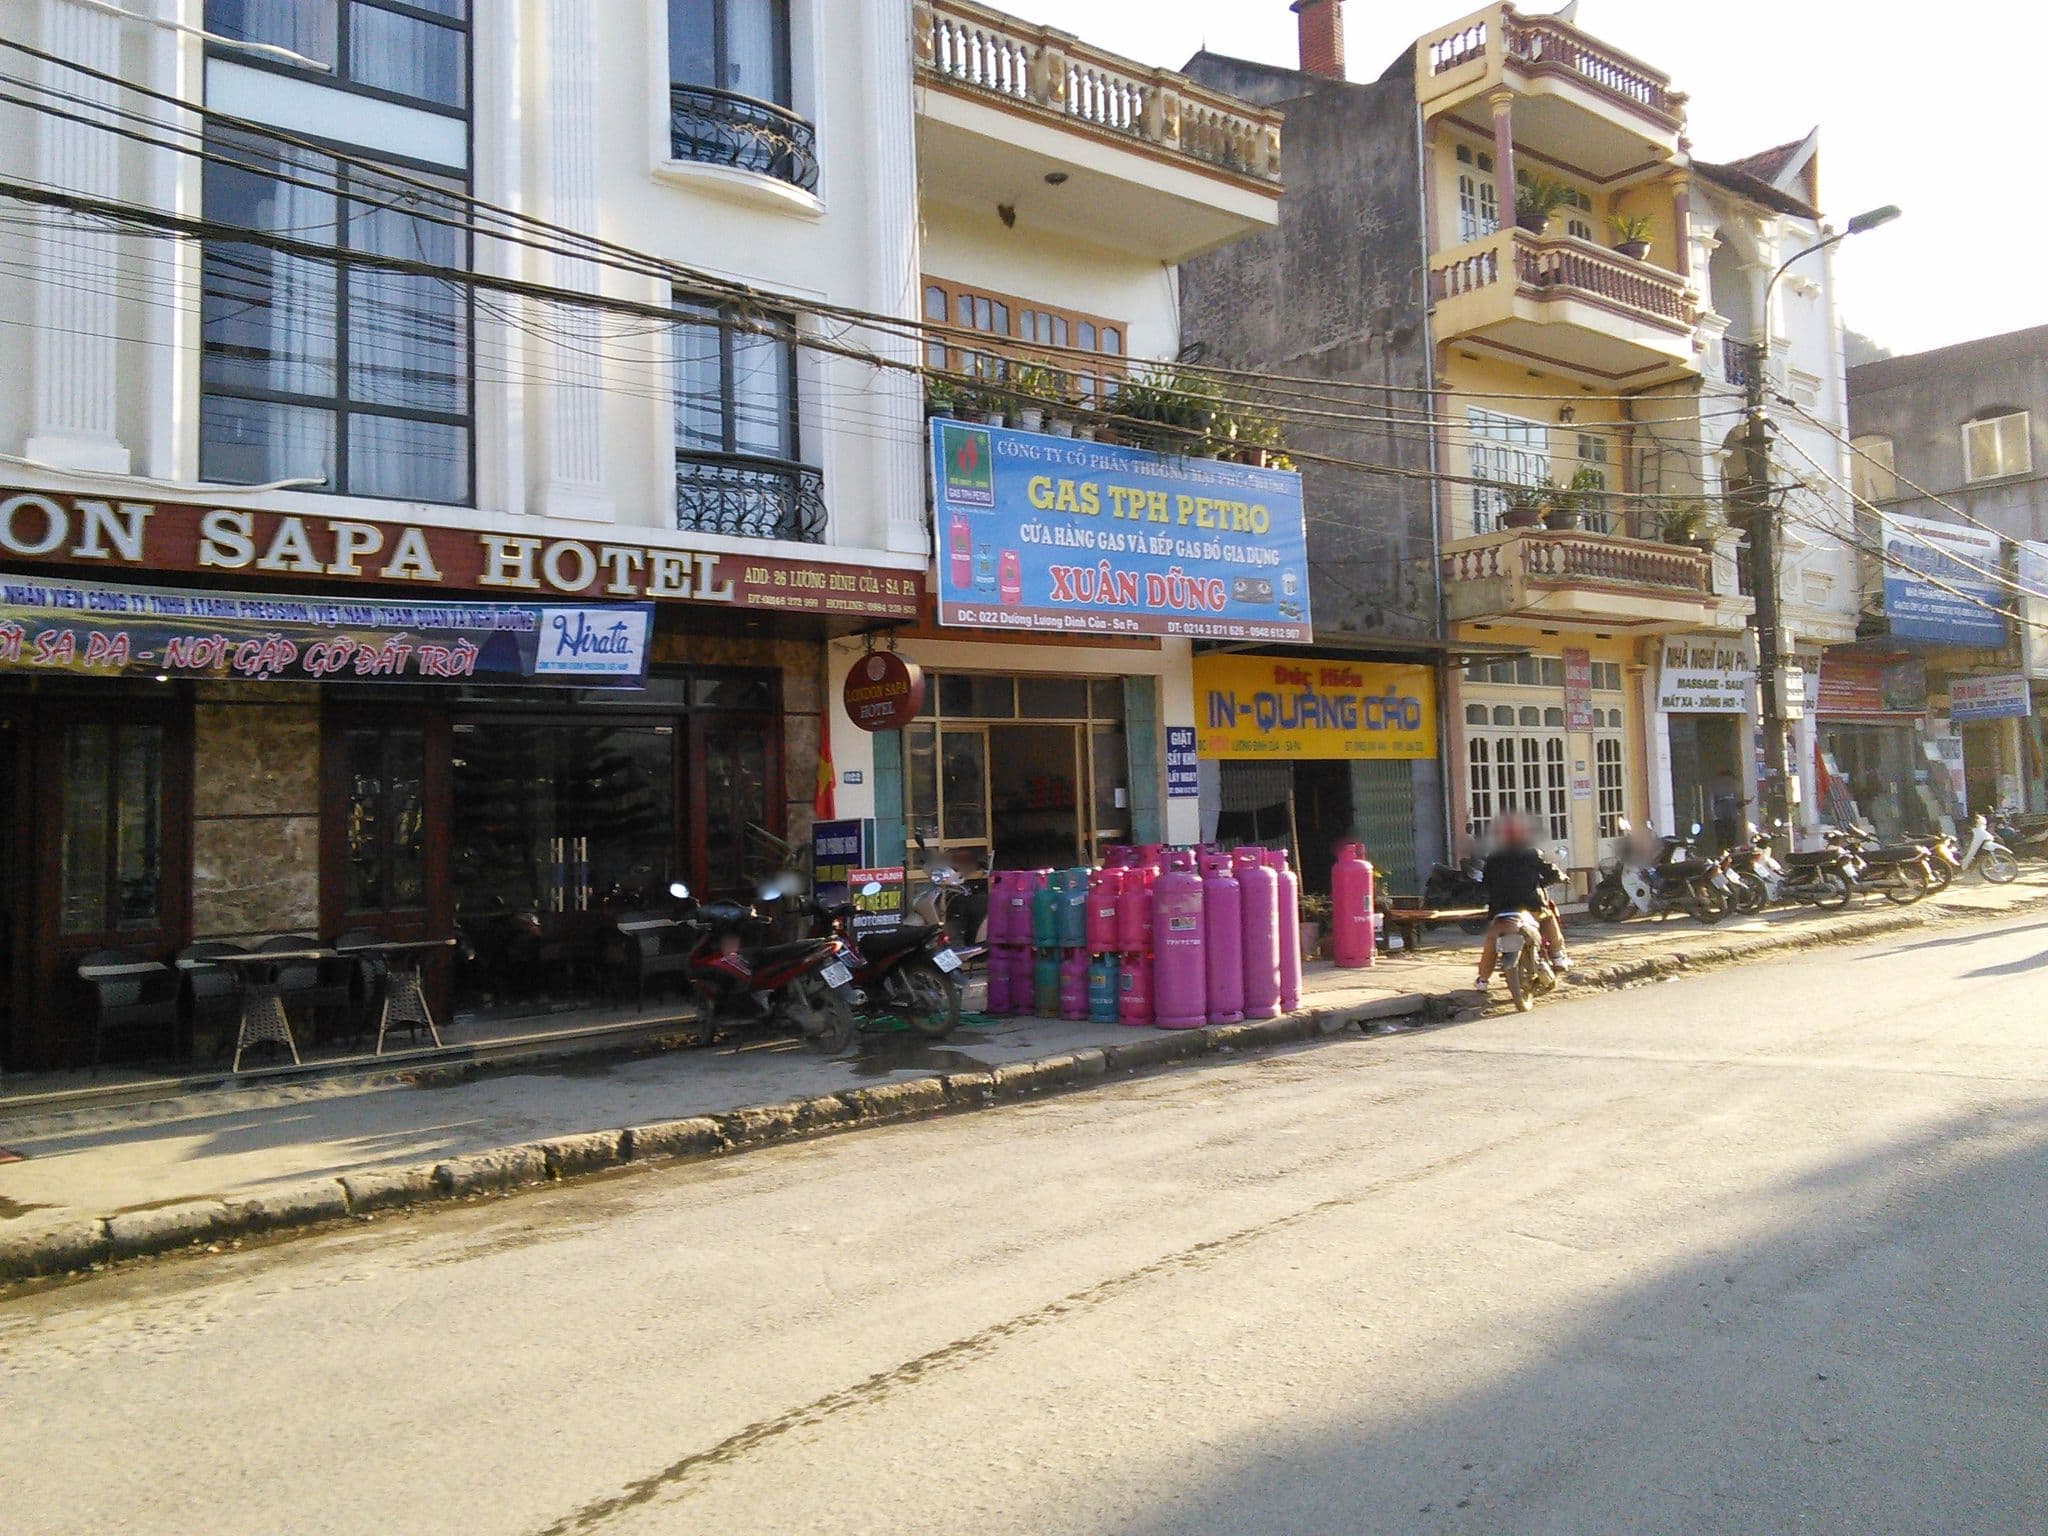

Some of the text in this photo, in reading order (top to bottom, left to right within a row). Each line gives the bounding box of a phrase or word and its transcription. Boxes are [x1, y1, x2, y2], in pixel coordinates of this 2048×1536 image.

[997, 438, 1040, 460] CÔNG
[1044, 447, 1063, 462] TY
[1066, 445, 1087, 467] CỔ
[1028, 475, 1271, 535] GAS TPH PETRO
[199, 509, 443, 582] SAPA
[479, 533, 735, 601] HOTEL
[1020, 518, 1053, 545] CỬA
[1055, 523, 1095, 549] HÀNG
[1097, 531, 1125, 552] GAS
[1127, 530, 1147, 554] VÀ
[1150, 530, 1174, 557] BẾP
[1176, 540, 1200, 559] GAS
[1223, 545, 1245, 563] GIA
[1246, 547, 1281, 569] DỤNG
[885, 578, 899, 595] SA
[902, 579, 916, 596] PA
[1049, 559, 1228, 612] XUÂN DŨNG
[553, 611, 634, 657] Hirata
[979, 611, 999, 624] 022
[32, 629, 77, 665] SA
[83, 630, 130, 668] PA
[136, 651, 155, 659] -
[162, 633, 229, 669] NƠI
[233, 632, 298, 680] GẶP
[303, 635, 357, 678] GỠ
[354, 632, 413, 676] ĐẤT
[417, 637, 479, 677] TRỜI
[1677, 678, 1719, 690] MASSAGE
[859, 701, 896, 718] HOTEL
[1363, 684, 1422, 731] CÁO
